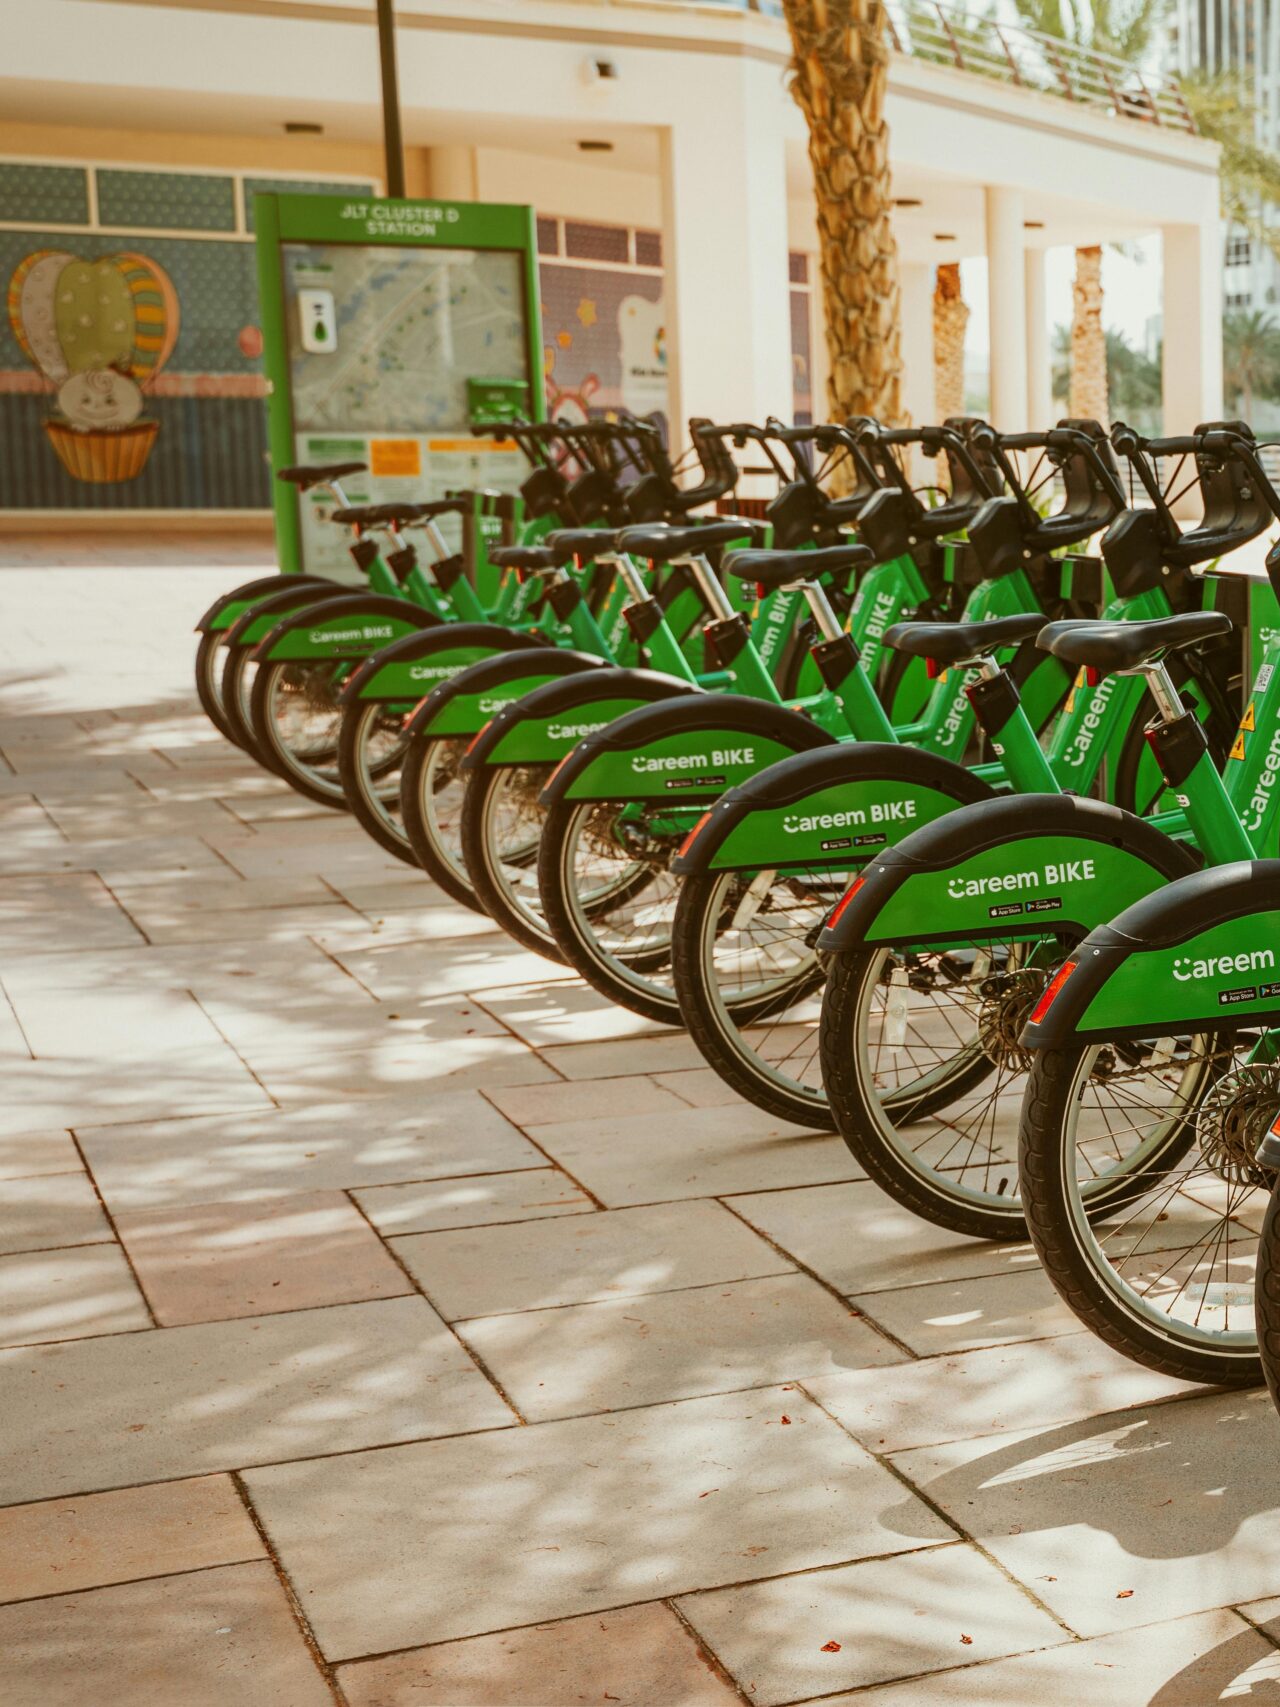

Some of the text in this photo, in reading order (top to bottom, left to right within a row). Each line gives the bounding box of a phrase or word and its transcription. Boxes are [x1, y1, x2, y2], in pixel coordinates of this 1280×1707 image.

[340, 203, 368, 219] JLT
[371, 204, 443, 222] CLUSTER
[365, 219, 437, 237] STATION
[759, 590, 794, 667] eem BIK
[864, 591, 896, 639] BIKE
[362, 626, 393, 639] BIKE
[1063, 676, 1117, 767] Careem
[631, 747, 755, 773] Careem BIKE
[783, 800, 917, 834] Careem BIKE
[947, 859, 1096, 899] Careem BIKE
[1172, 949, 1275, 981] Careem
